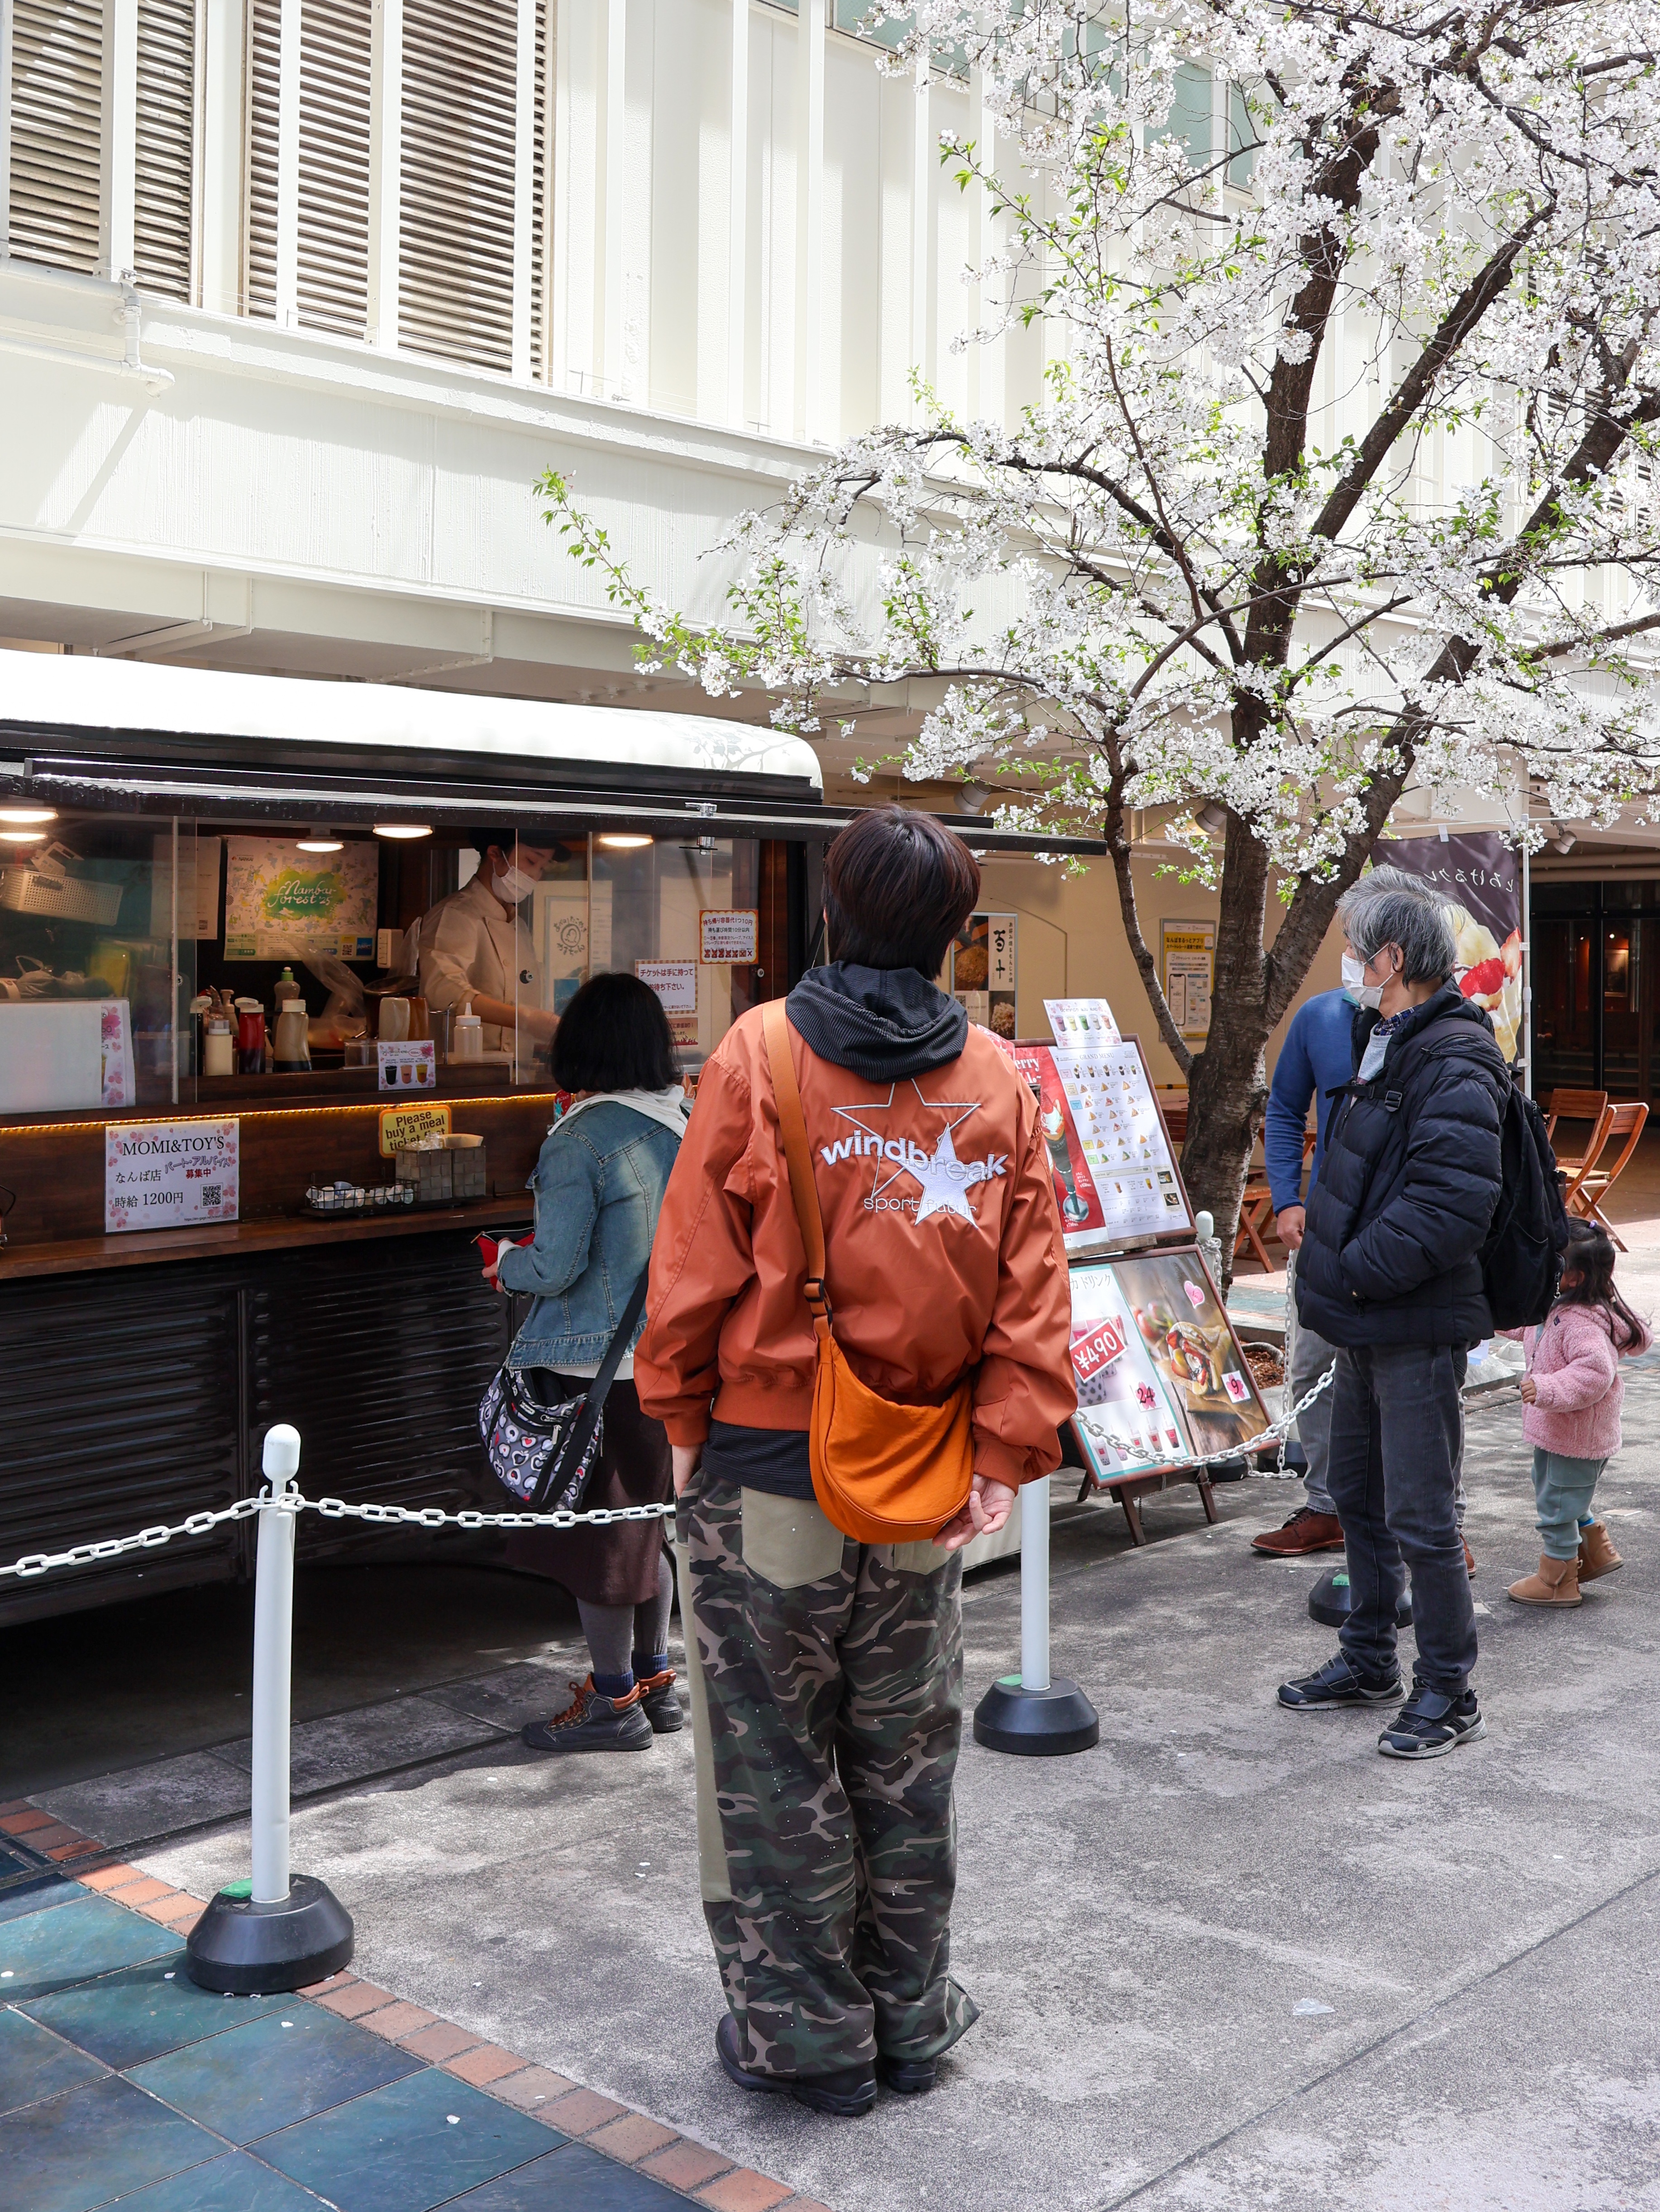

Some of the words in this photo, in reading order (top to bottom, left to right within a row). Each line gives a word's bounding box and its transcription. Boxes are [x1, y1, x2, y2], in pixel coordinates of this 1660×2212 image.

[640, 968, 693, 977] チケットは手に持って
[649, 983, 684, 991] お待ち下さい。
[386, 1127, 405, 1139] buy
[420, 1115, 445, 1130] meal
[396, 1111, 431, 1127] Please
[122, 1136, 224, 1155] MOMI&TOY'S
[820, 1130, 1008, 1183] windbreak
[115, 1169, 162, 1183] なんば店
[186, 1168, 211, 1179] 募集中
[115, 1195, 138, 1208] 時給
[143, 1192, 183, 1205] 1200円
[863, 1196, 920, 1213] sport
[1074, 1331, 1117, 1371] ¥490
[1137, 1386, 1154, 1404] 24
[1231, 1379, 1239, 1395] 9
